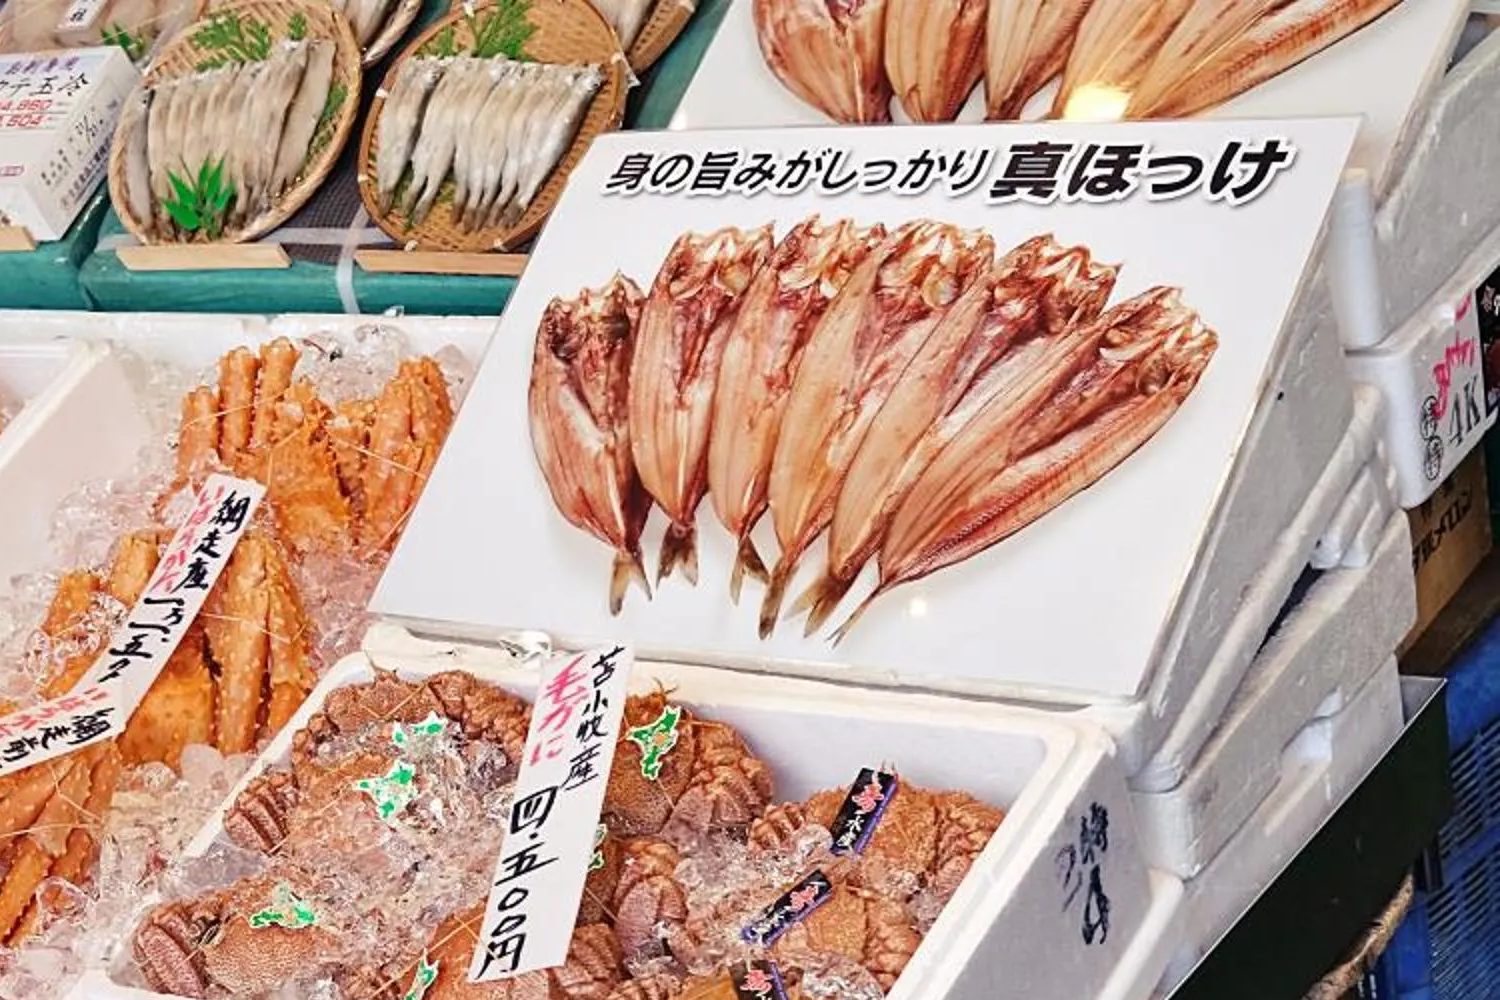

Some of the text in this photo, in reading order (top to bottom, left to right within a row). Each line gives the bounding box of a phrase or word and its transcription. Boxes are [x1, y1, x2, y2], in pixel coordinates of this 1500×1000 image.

[605, 140, 1290, 202] 身の旨みがしっかり 真ほっけ
[171, 490, 251, 595] 網走産
[529, 653, 590, 768] 毛がに
[559, 645, 626, 792] 苫小牧産
